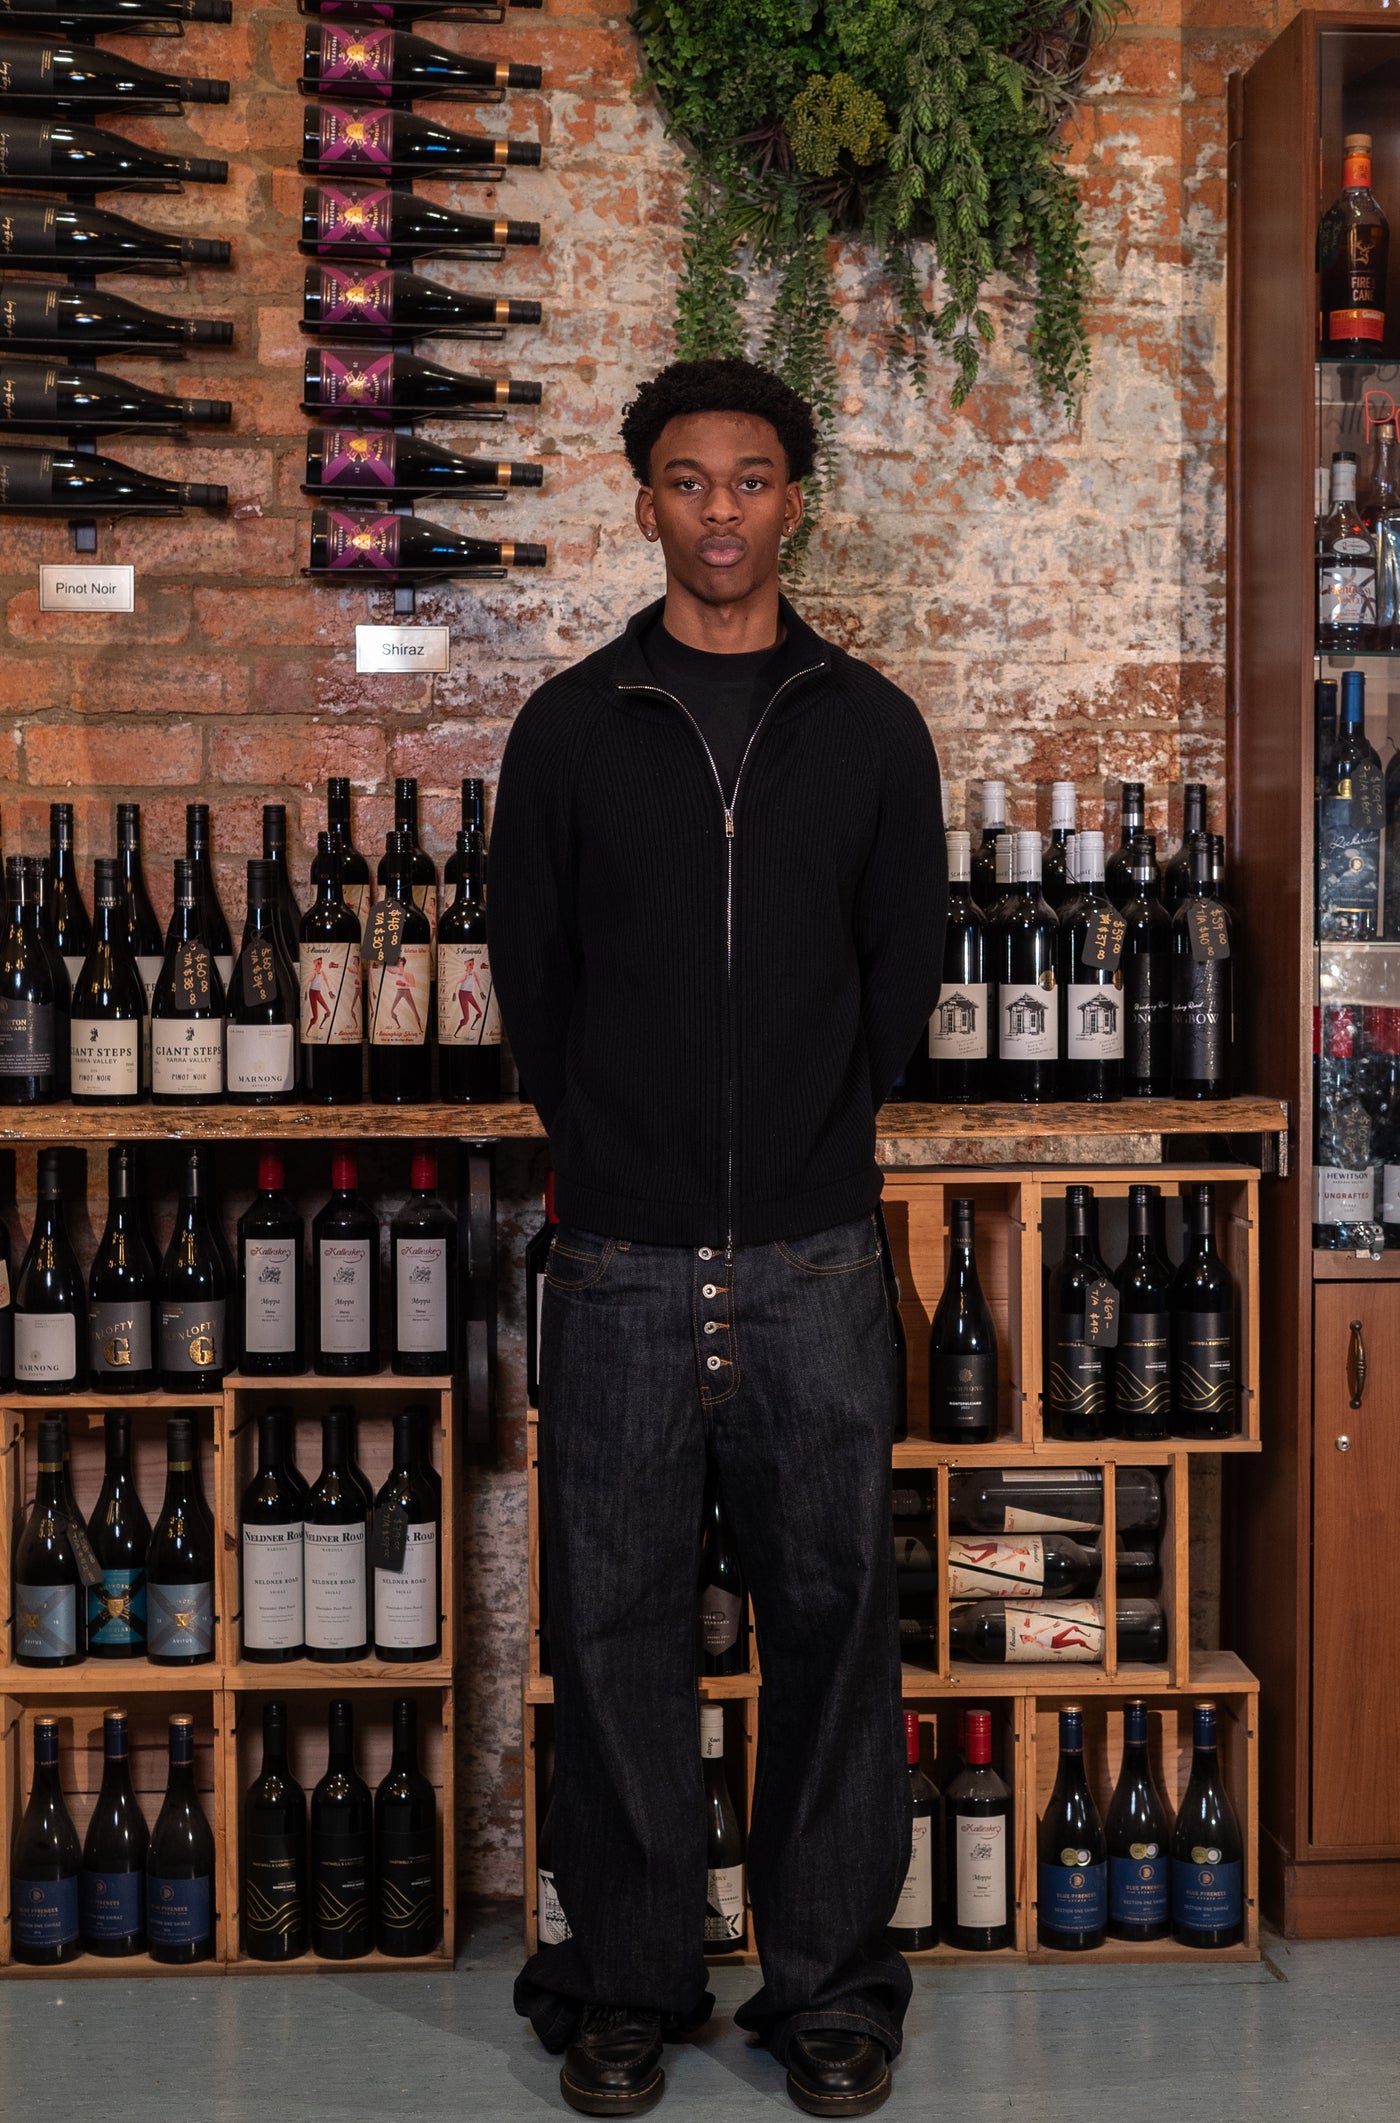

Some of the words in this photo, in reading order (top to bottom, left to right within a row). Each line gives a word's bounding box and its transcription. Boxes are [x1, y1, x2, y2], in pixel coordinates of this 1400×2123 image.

[1351, 276, 1370, 288] FIRE
[1352, 290, 1374, 302] CANE
[56, 582, 88, 596] Pinot
[90, 582, 117, 595] Noir
[382, 643, 424, 657] Shiraz
[374, 912, 385, 926] T/A
[96, 1048, 132, 1057] STEPS
[156, 1046, 190, 1056] GIANT
[193, 1046, 222, 1056] STEPS
[238, 1075, 282, 1083] MARNONG
[250, 1246, 291, 1260] Kalleske
[324, 1247, 365, 1261] Kalleske
[400, 1246, 442, 1260] Kalleske
[260, 1298, 280, 1306] Moppa
[334, 1298, 354, 1306] Moppa
[411, 1298, 431, 1306] Moppa
[1090, 1290, 1099, 1306] T/A
[104, 1336, 132, 1366] G
[188, 1336, 216, 1366] G
[245, 1531, 284, 1542] NELDNER
[306, 1531, 339, 1542] NELDNER
[342, 1532, 364, 1542] ROAD
[413, 1531, 435, 1542] ROAD
[960, 1824, 1002, 1838] Kalleske
[972, 1874, 992, 1882] Moppa
